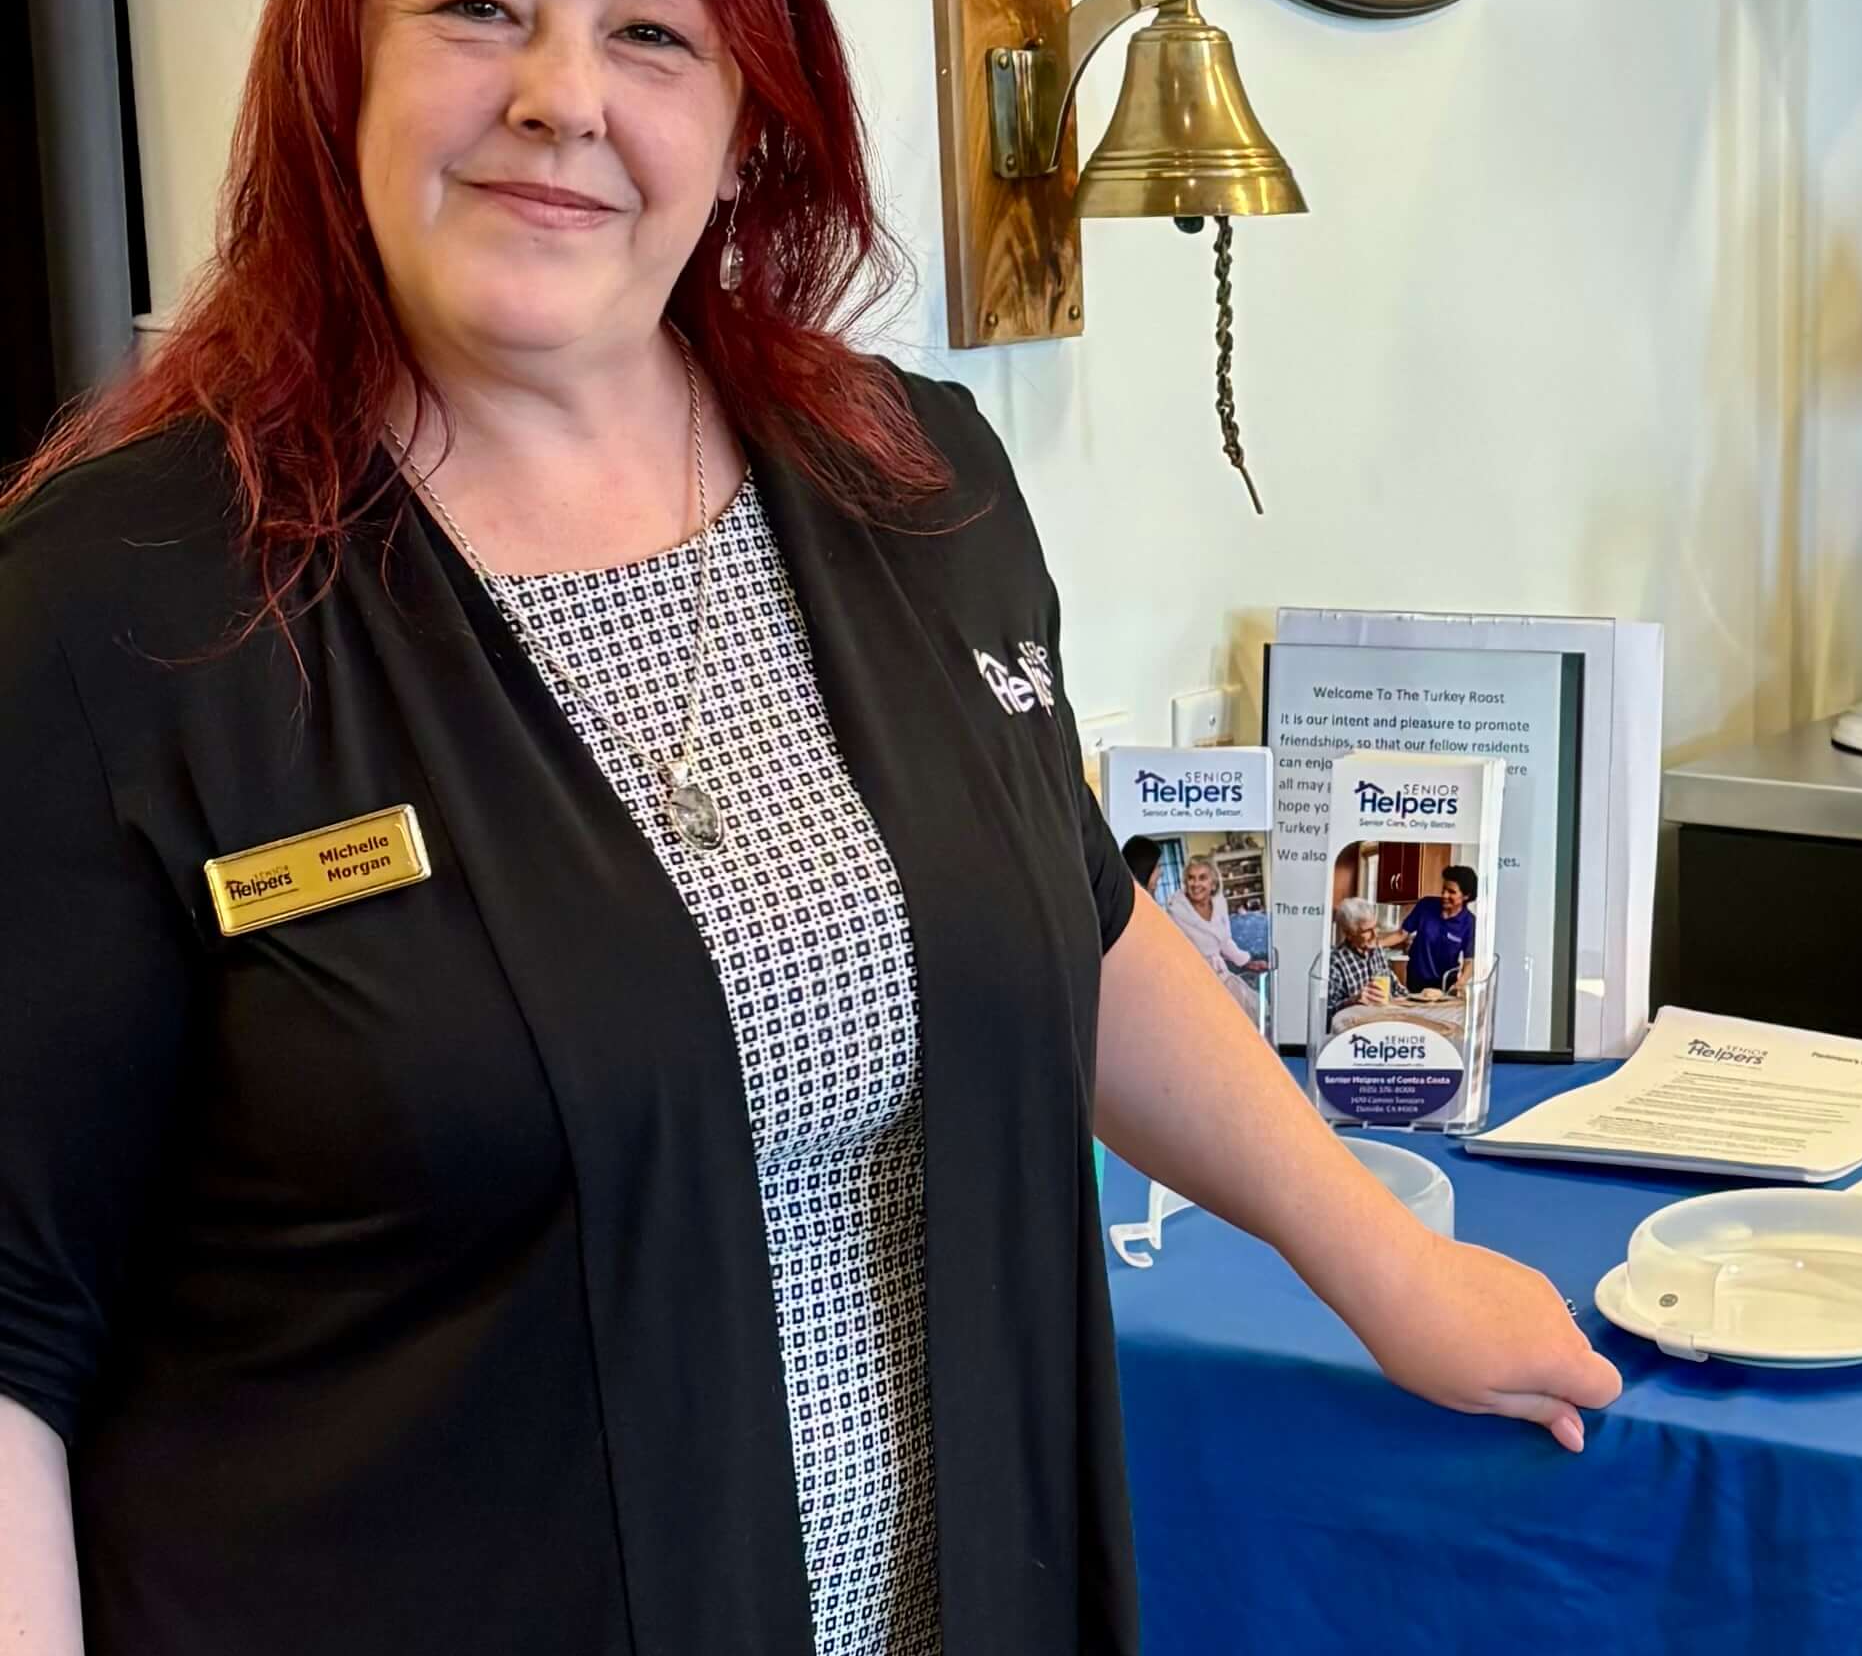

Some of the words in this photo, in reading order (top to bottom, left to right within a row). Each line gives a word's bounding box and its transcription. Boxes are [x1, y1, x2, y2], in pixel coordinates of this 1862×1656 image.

[1313, 686, 1373, 701] Welcome
[1376, 687, 1392, 701] To
[1396, 688, 1419, 702] The
[1423, 689, 1465, 705] Turkey
[1469, 691, 1505, 704] Roost
[1280, 713, 1290, 725] It
[1293, 713, 1303, 725] is
[1306, 716, 1328, 726] our
[1331, 714, 1369, 727] intent
[1373, 716, 1397, 729] and
[1400, 716, 1455, 734] pleasure
[1458, 718, 1472, 731] to
[1475, 720, 1530, 736] promote
[1280, 734, 1354, 750] friendships,
[1357, 739, 1372, 749] so
[1375, 736, 1400, 750] that
[1404, 739, 1426, 751] our
[1429, 737, 1469, 753] fellow
[1471, 740, 1530, 754] residents
[1279, 758, 1302, 770] can
[1305, 756, 1333, 773] enjo
[1506, 765, 1528, 776] ere
[1185, 771, 1243, 784] SENIOR
[1142, 779, 1243, 808] Helpers
[1278, 779, 1295, 791] all
[1297, 781, 1325, 795] may
[1403, 784, 1459, 797] SENIOR
[1278, 801, 1310, 815] hope
[1313, 803, 1329, 815] yo
[1360, 790, 1458, 819] Helpers
[1142, 808, 1168, 818] Senior
[1277, 821, 1322, 836] Turkey
[1359, 818, 1384, 828] Senior
[319, 836, 389, 865] Michelle
[1277, 849, 1299, 861] We
[1301, 848, 1327, 863] also
[328, 854, 391, 883] Morgan
[229, 871, 294, 901] Helpers
[1275, 903, 1299, 916] The
[1385, 1034, 1426, 1045] SENIOR
[1353, 1041, 1426, 1062] Helpers
[1687, 1045, 1765, 1067] Helpers
